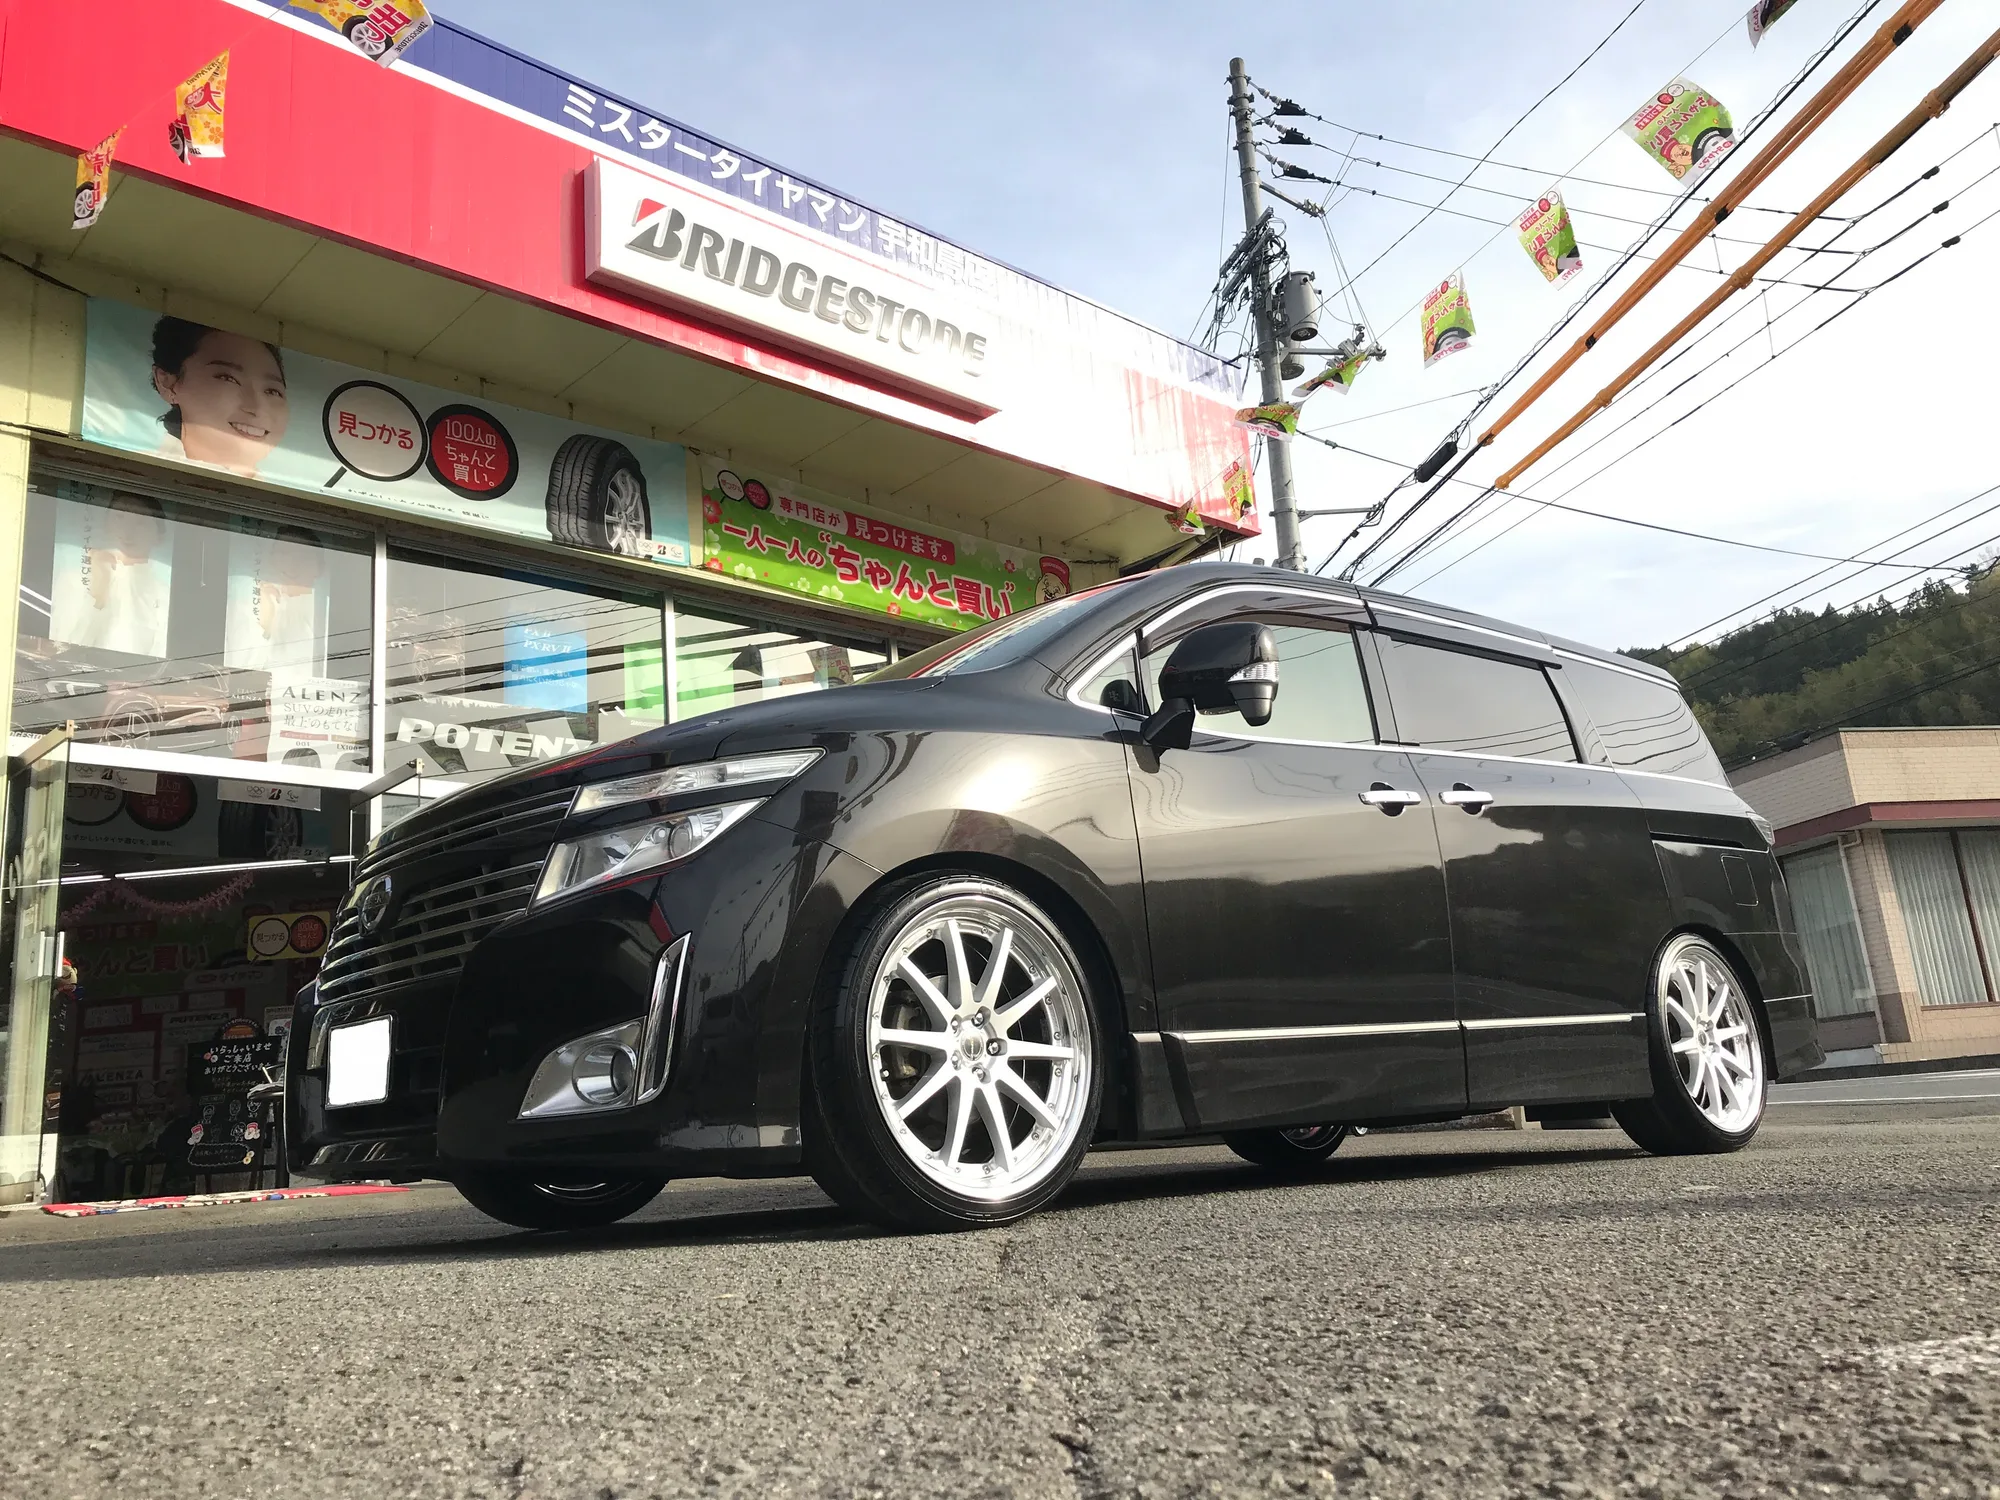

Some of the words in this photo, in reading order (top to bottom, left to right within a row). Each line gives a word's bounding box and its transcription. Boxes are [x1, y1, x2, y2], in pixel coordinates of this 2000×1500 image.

[562, 84, 870, 233] ミスタータイヤマン
[624, 197, 987, 378] BRIDGESTONE
[338, 410, 415, 451] 見つかる
[445, 418, 497, 447] 100人の
[445, 443, 496, 470] ちゃんと
[453, 463, 495, 487] 買い。
[722, 522, 826, 569] 一人一人の
[778, 496, 841, 527] 専門店が
[854, 519, 948, 562] 見つけます。
[282, 686, 369, 704] ALENZ
[397, 717, 594, 759] POTENZ
[210, 1042, 272, 1055] いらっしゃいませ
